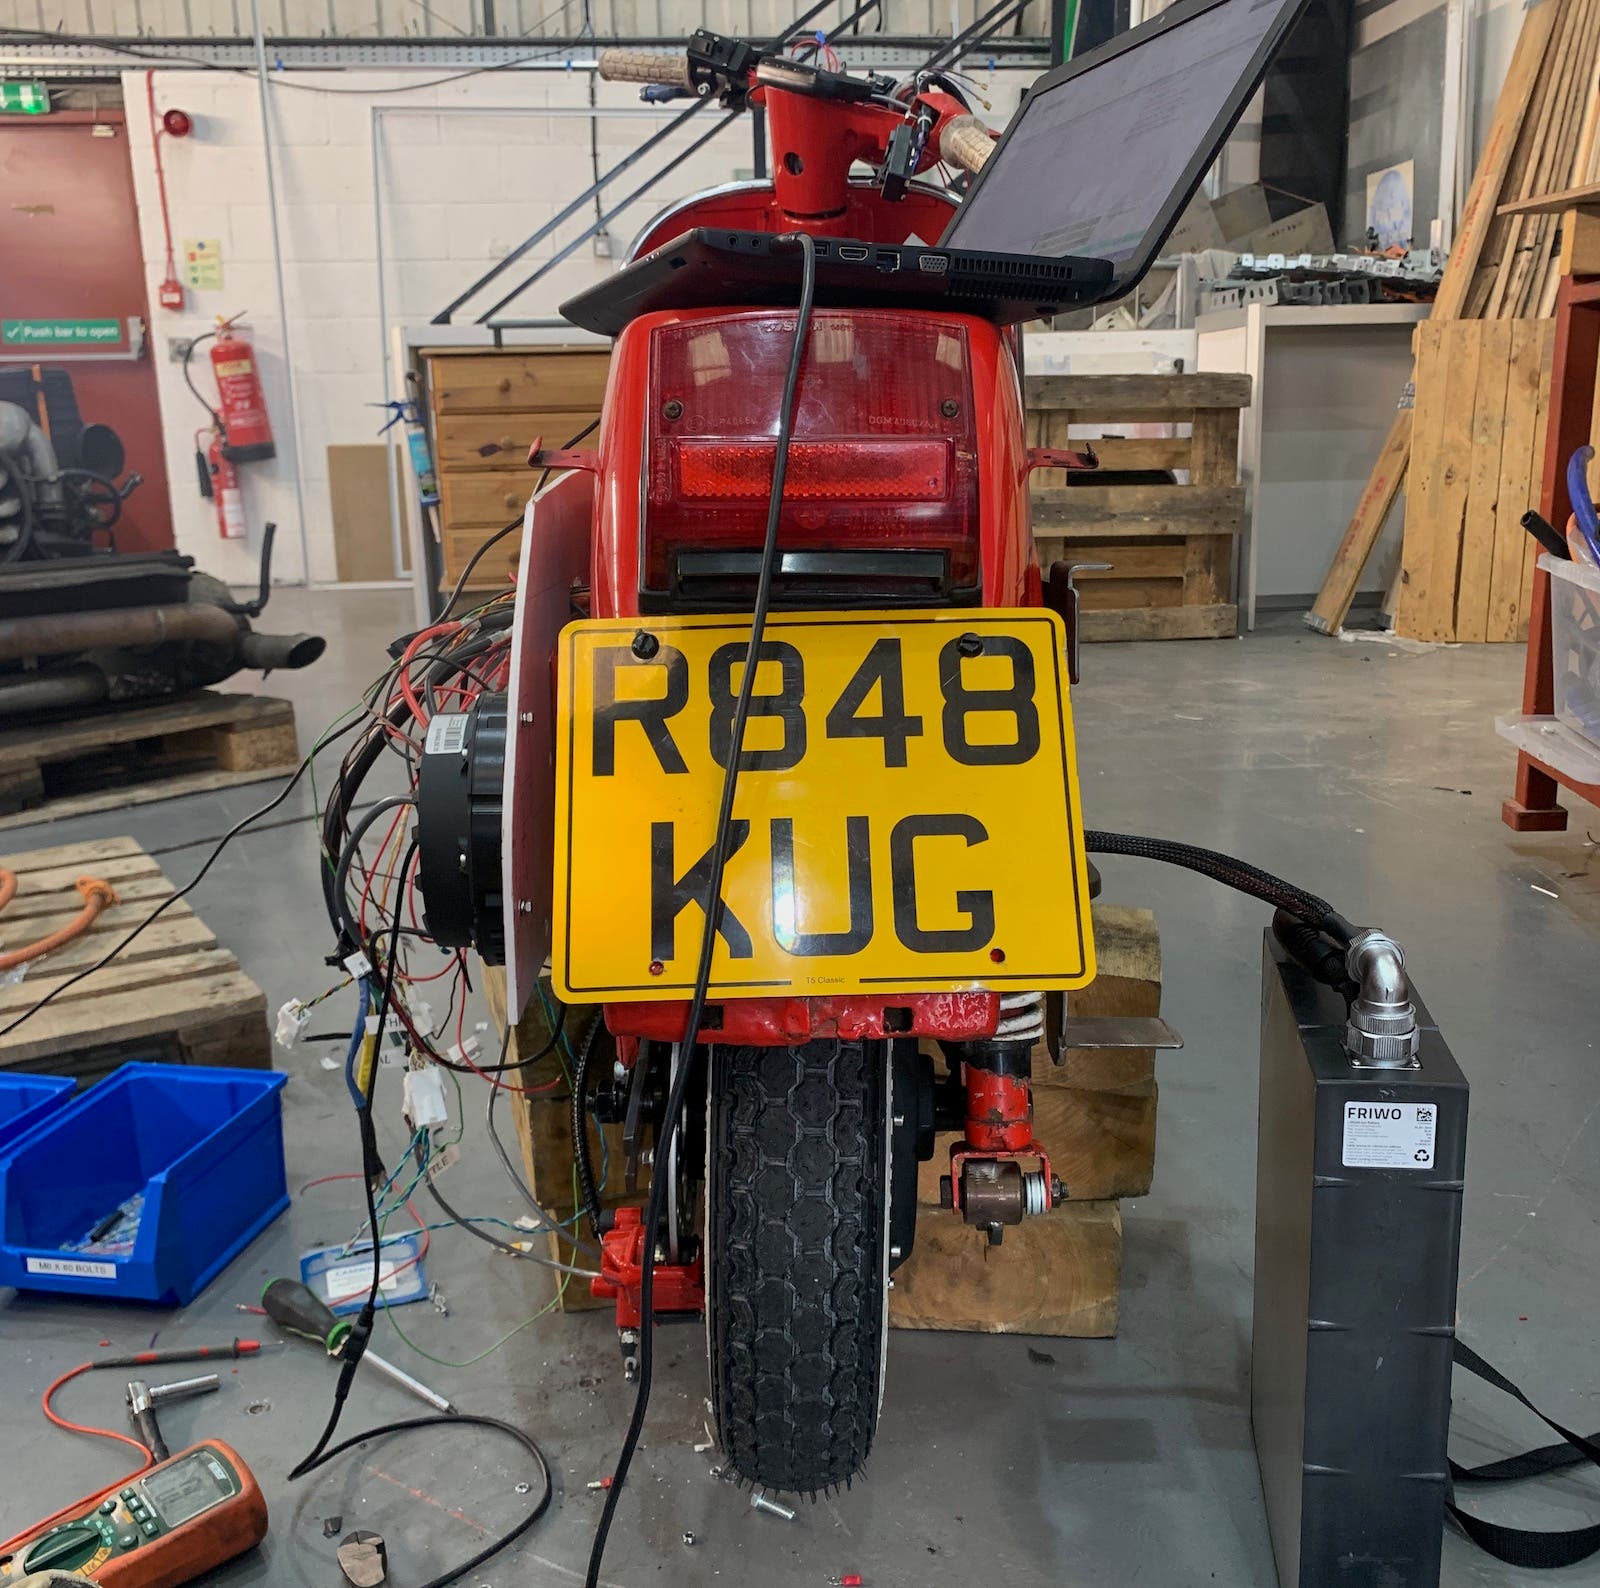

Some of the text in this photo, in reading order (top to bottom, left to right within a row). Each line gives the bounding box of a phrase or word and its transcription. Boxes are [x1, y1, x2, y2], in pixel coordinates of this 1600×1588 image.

[592, 635, 1041, 777] R848
[651, 813, 996, 962] KUG
[817, 976, 846, 984] Classic
[1348, 1107, 1402, 1120] FRIWO
